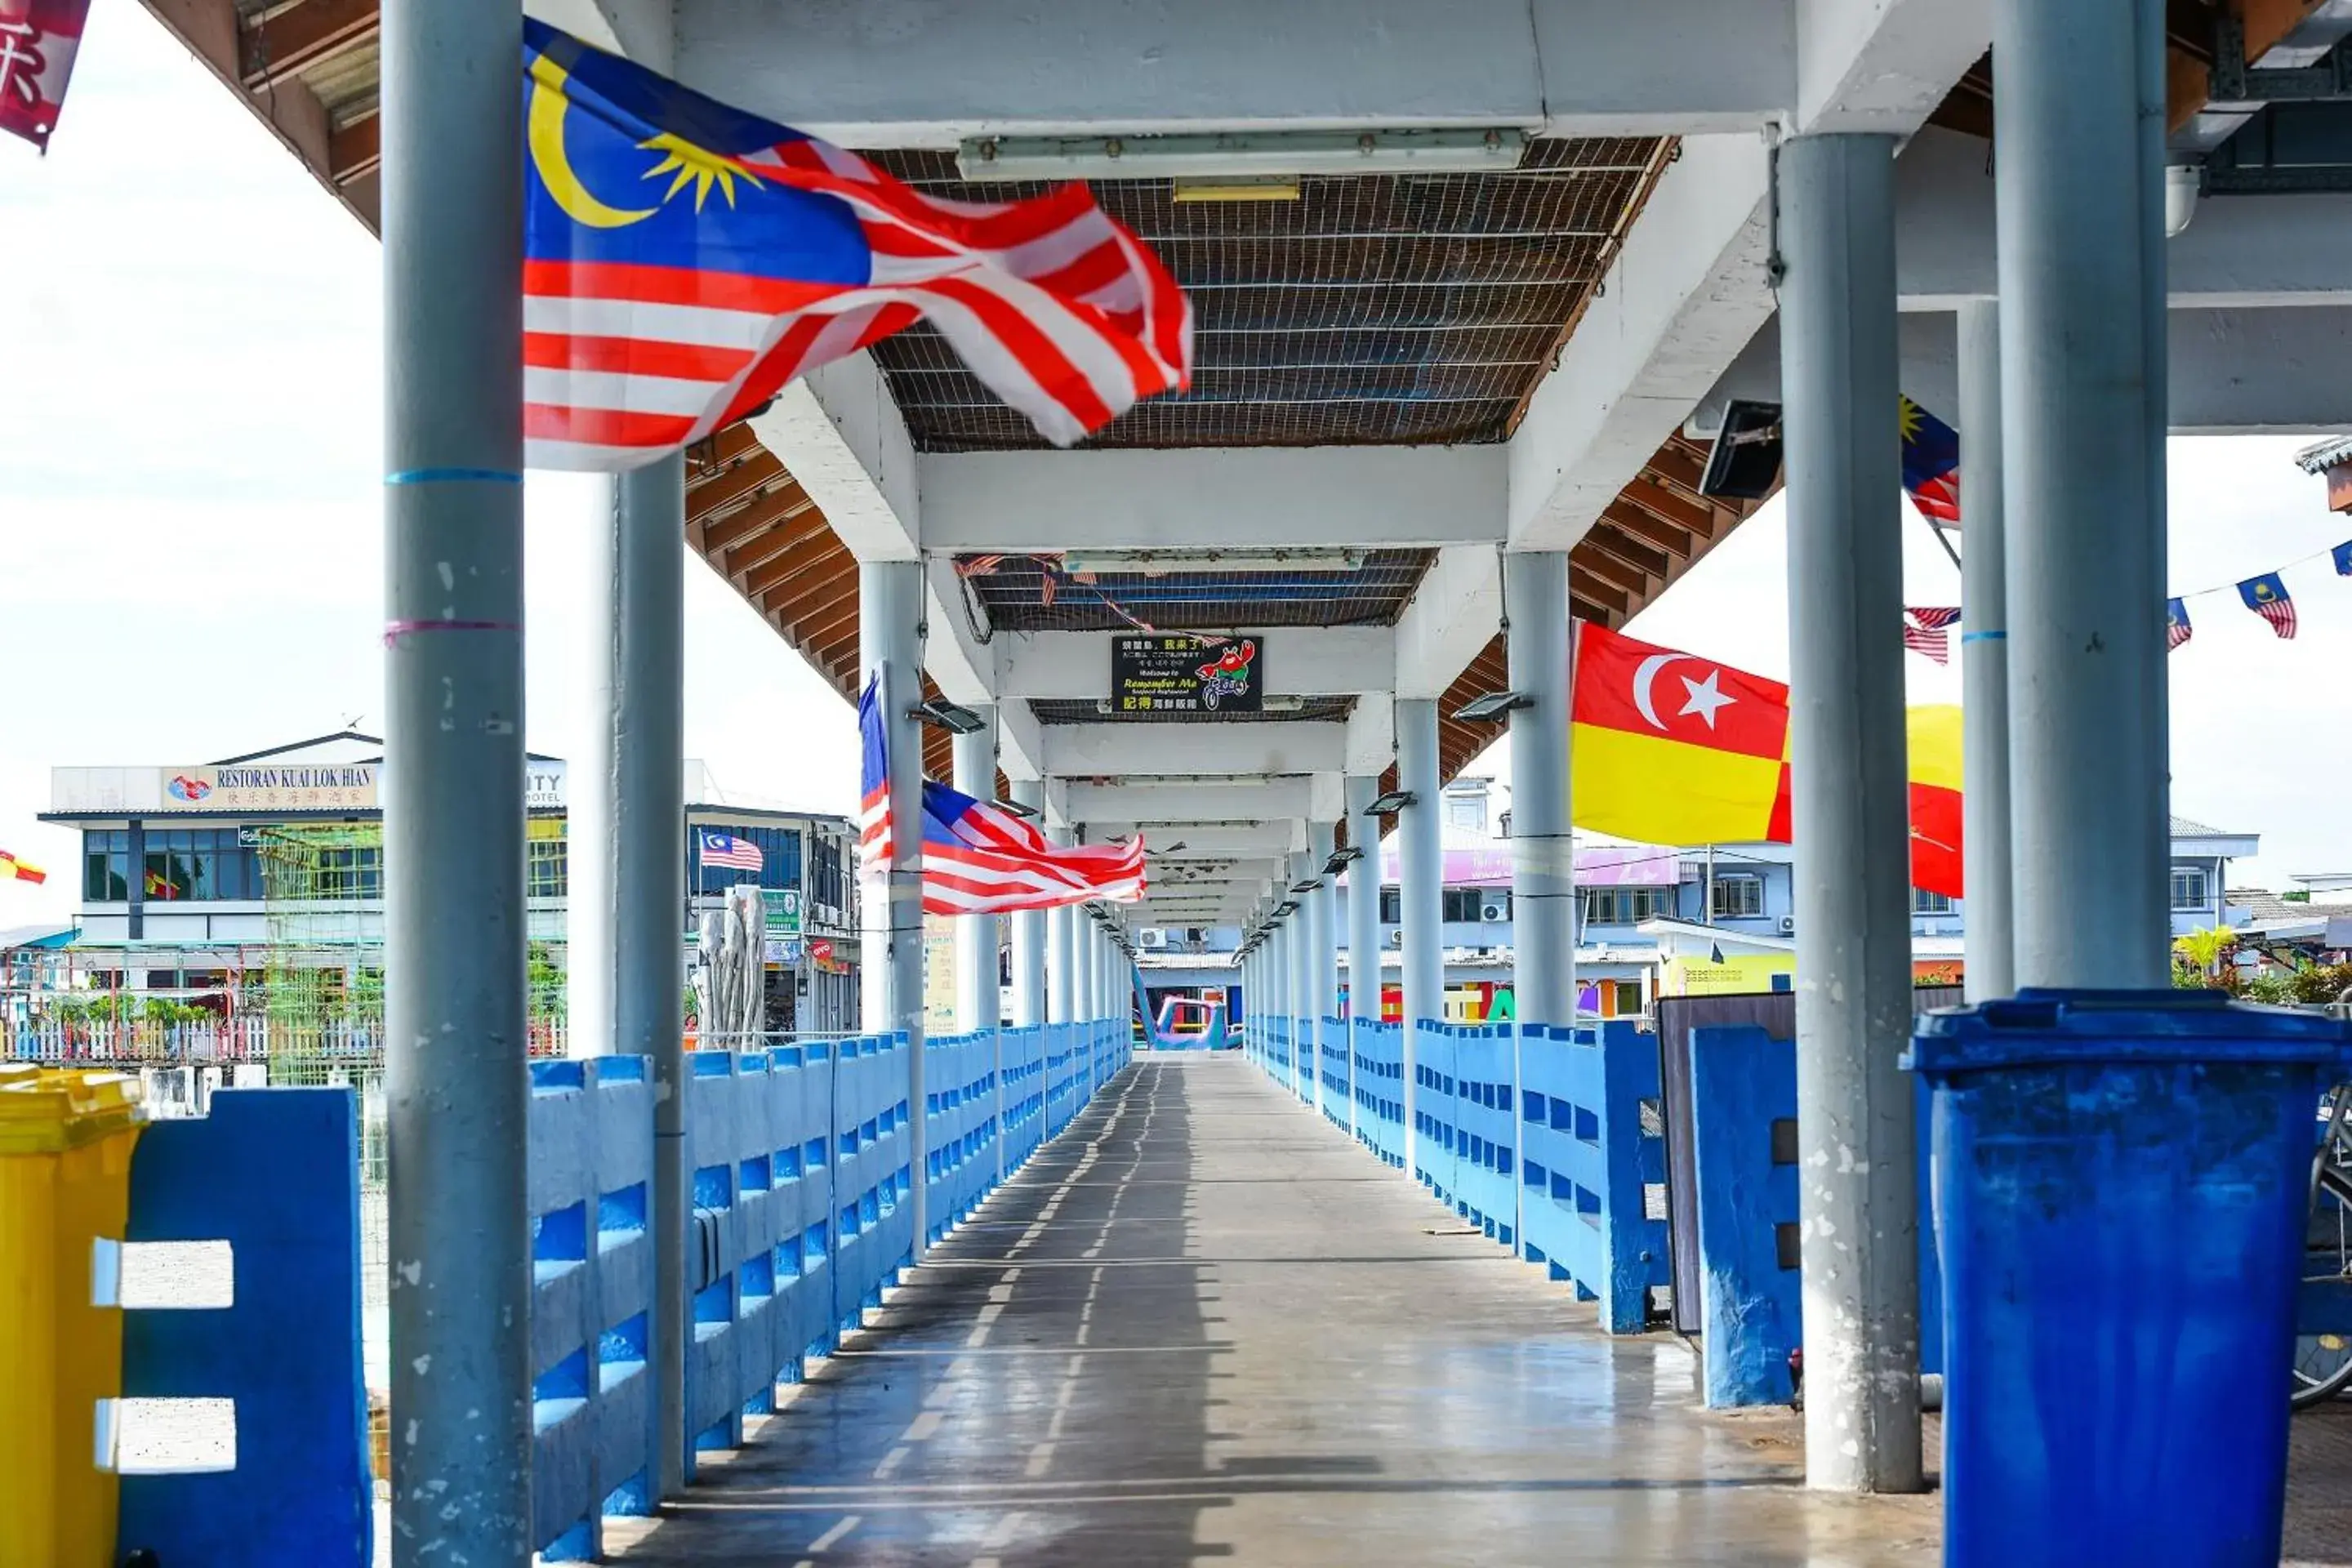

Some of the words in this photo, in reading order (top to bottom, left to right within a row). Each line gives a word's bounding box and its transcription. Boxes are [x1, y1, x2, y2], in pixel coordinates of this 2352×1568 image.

[1124, 678, 1175, 688] Remember
[217, 769, 278, 788] RESTORAN
[282, 768, 310, 788] KUAI
[314, 768, 338, 787] LOK
[342, 768, 370, 787] HIAN
[526, 775, 561, 791] ITY
